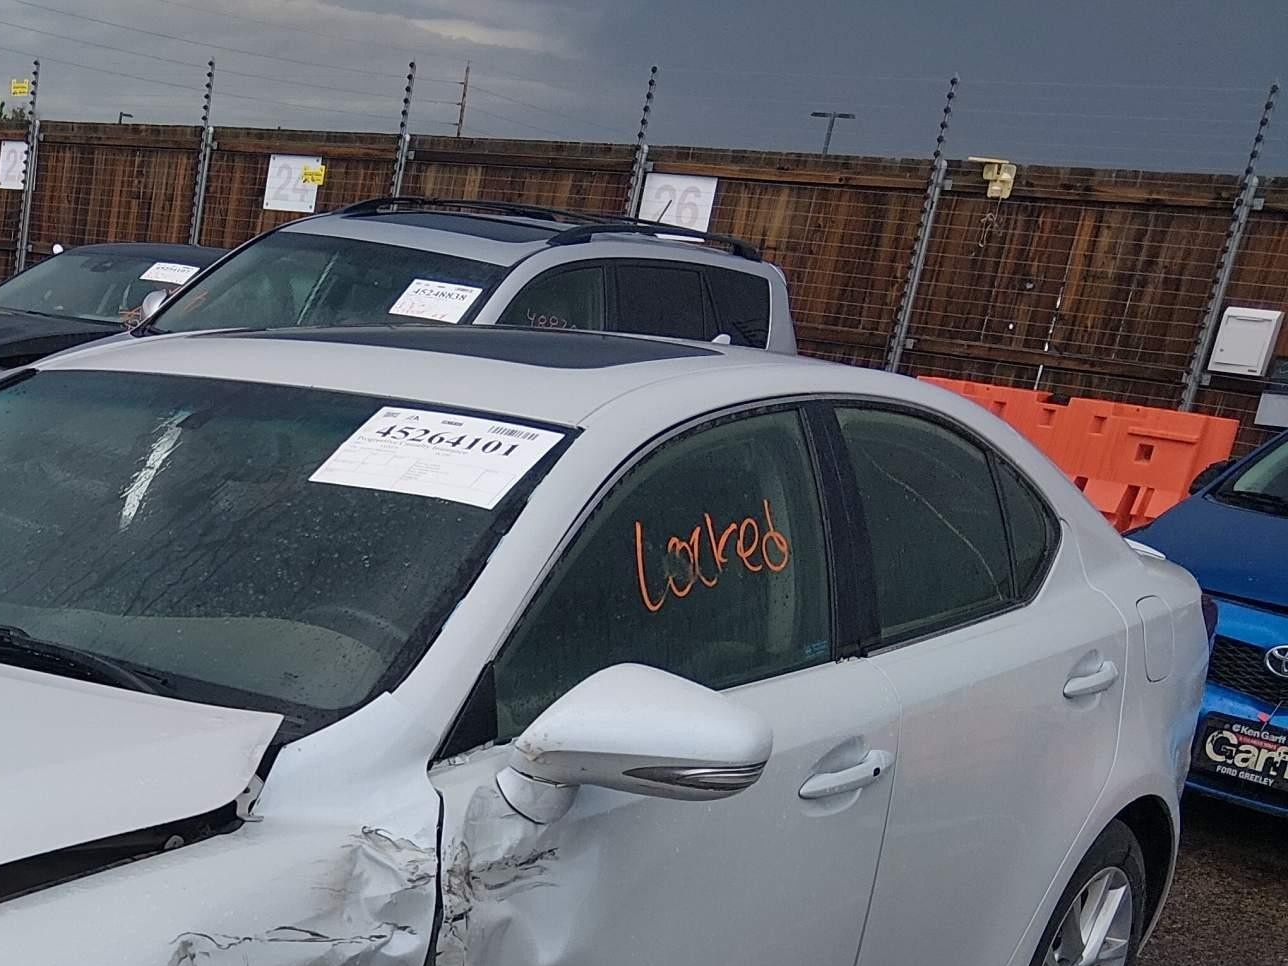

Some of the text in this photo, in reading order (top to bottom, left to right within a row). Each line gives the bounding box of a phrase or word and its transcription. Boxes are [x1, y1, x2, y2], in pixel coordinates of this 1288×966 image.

[654, 184, 702, 227] 26
[375, 424, 520, 457] 45264101
[1216, 765, 1274, 787] FORD GREELEY
